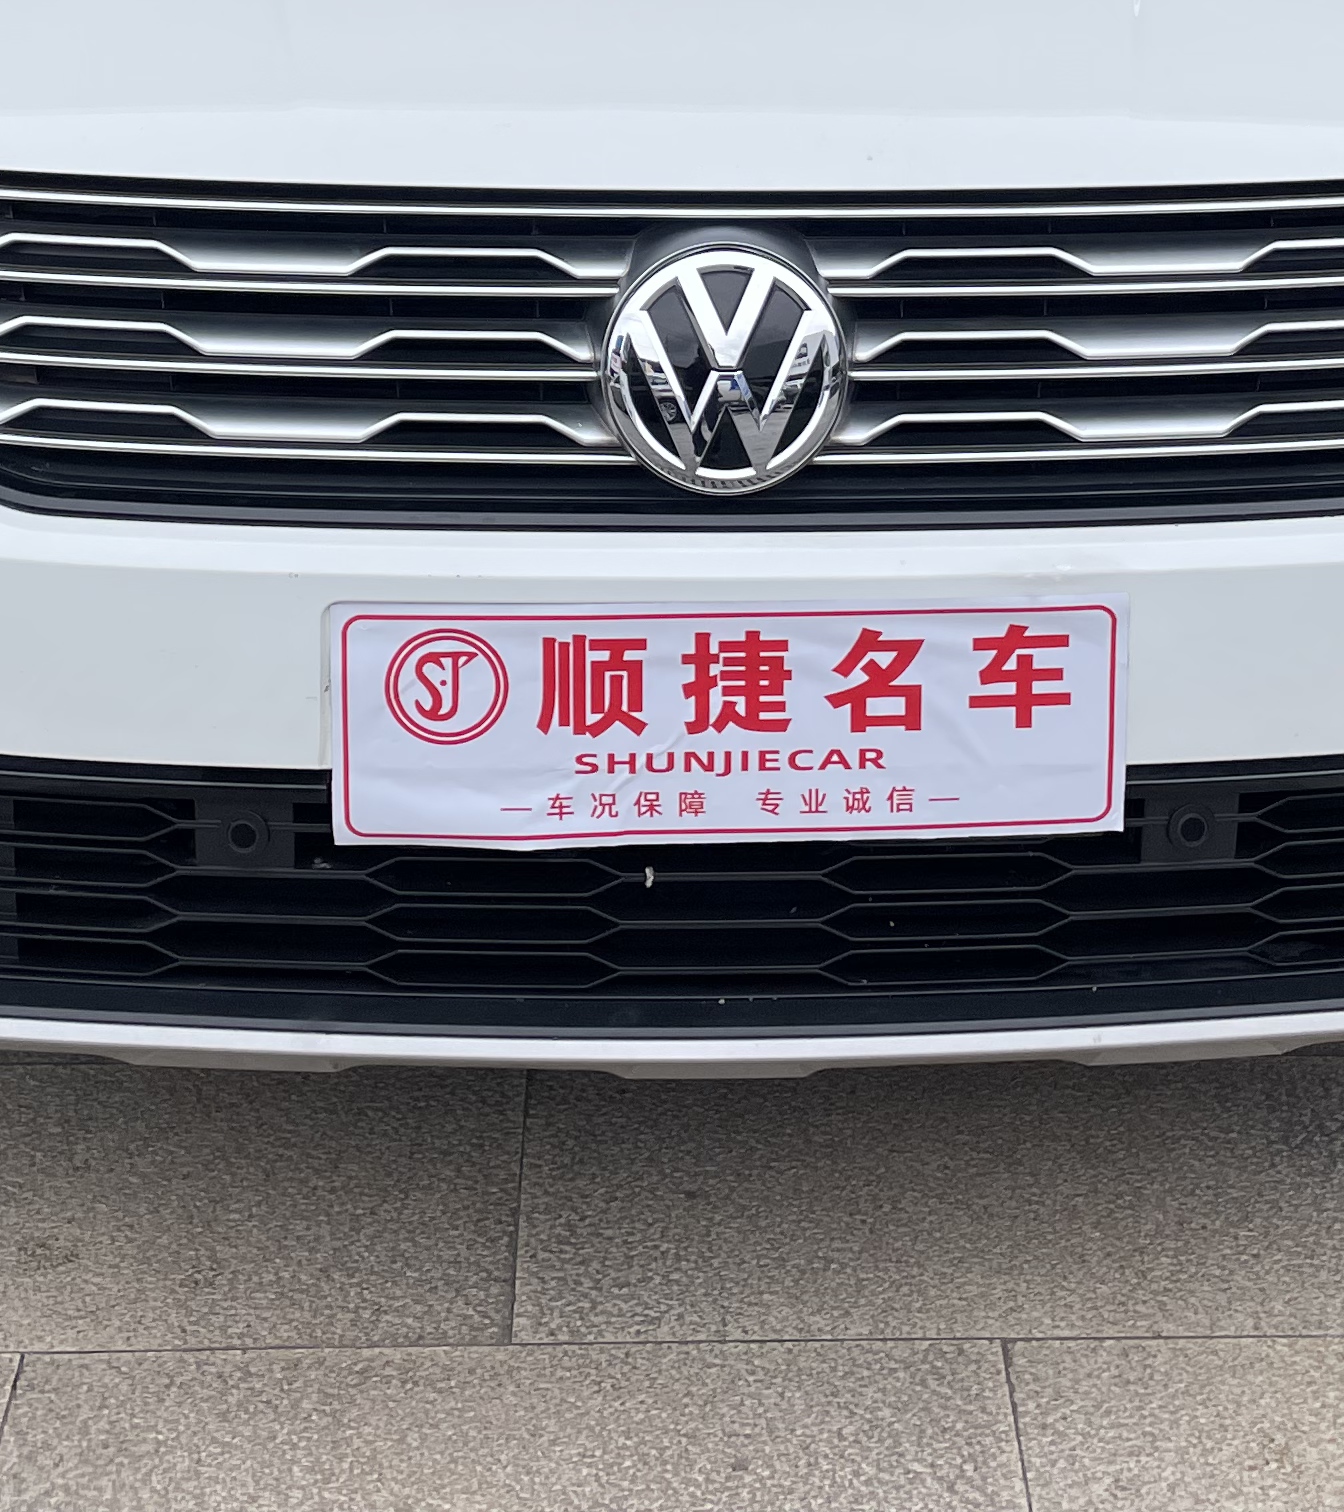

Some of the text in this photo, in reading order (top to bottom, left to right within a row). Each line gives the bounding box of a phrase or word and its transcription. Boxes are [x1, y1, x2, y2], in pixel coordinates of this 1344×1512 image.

[535, 624, 1072, 738] 顺捷名车
[574, 747, 887, 777] SHUNJIECAR
